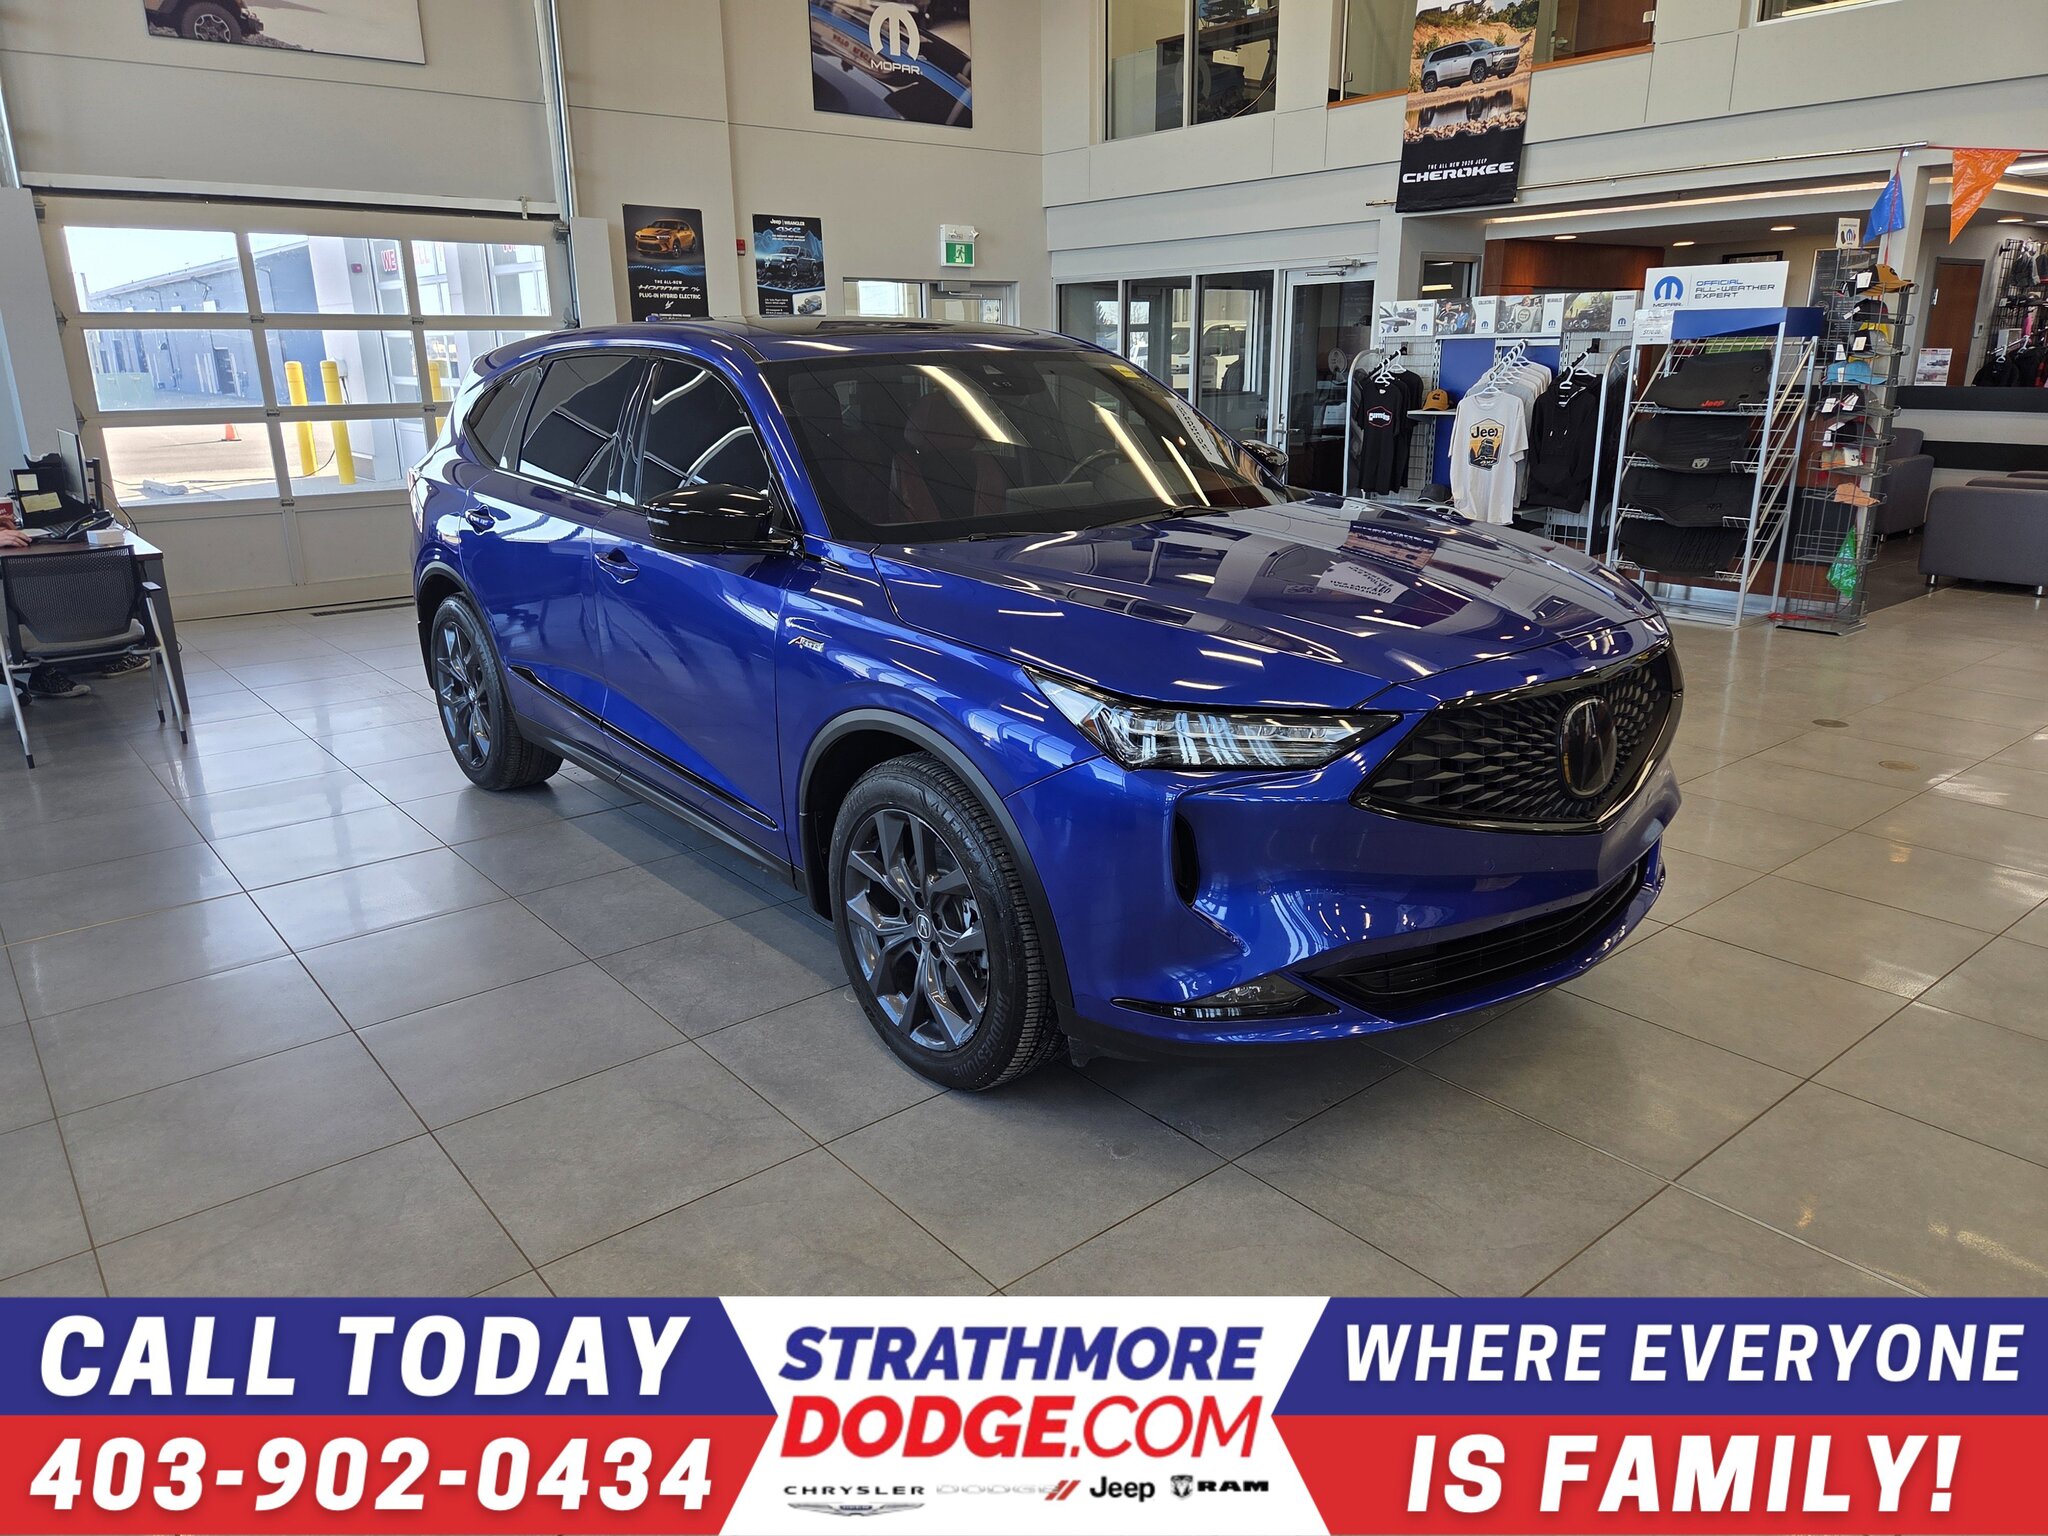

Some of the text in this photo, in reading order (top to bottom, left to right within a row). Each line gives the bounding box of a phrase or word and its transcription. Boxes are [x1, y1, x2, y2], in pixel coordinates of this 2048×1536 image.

[870, 59, 921, 75] MOPAR
[1475, 157, 1488, 165] JEEP
[1402, 161, 1515, 184] CHEROKEE
[1696, 278, 1744, 287] OFFICIAL
[1695, 283, 1776, 293] ALL-WEATHER
[1694, 291, 1739, 300] EXPERT
[1700, 400, 1726, 408] Jeep
